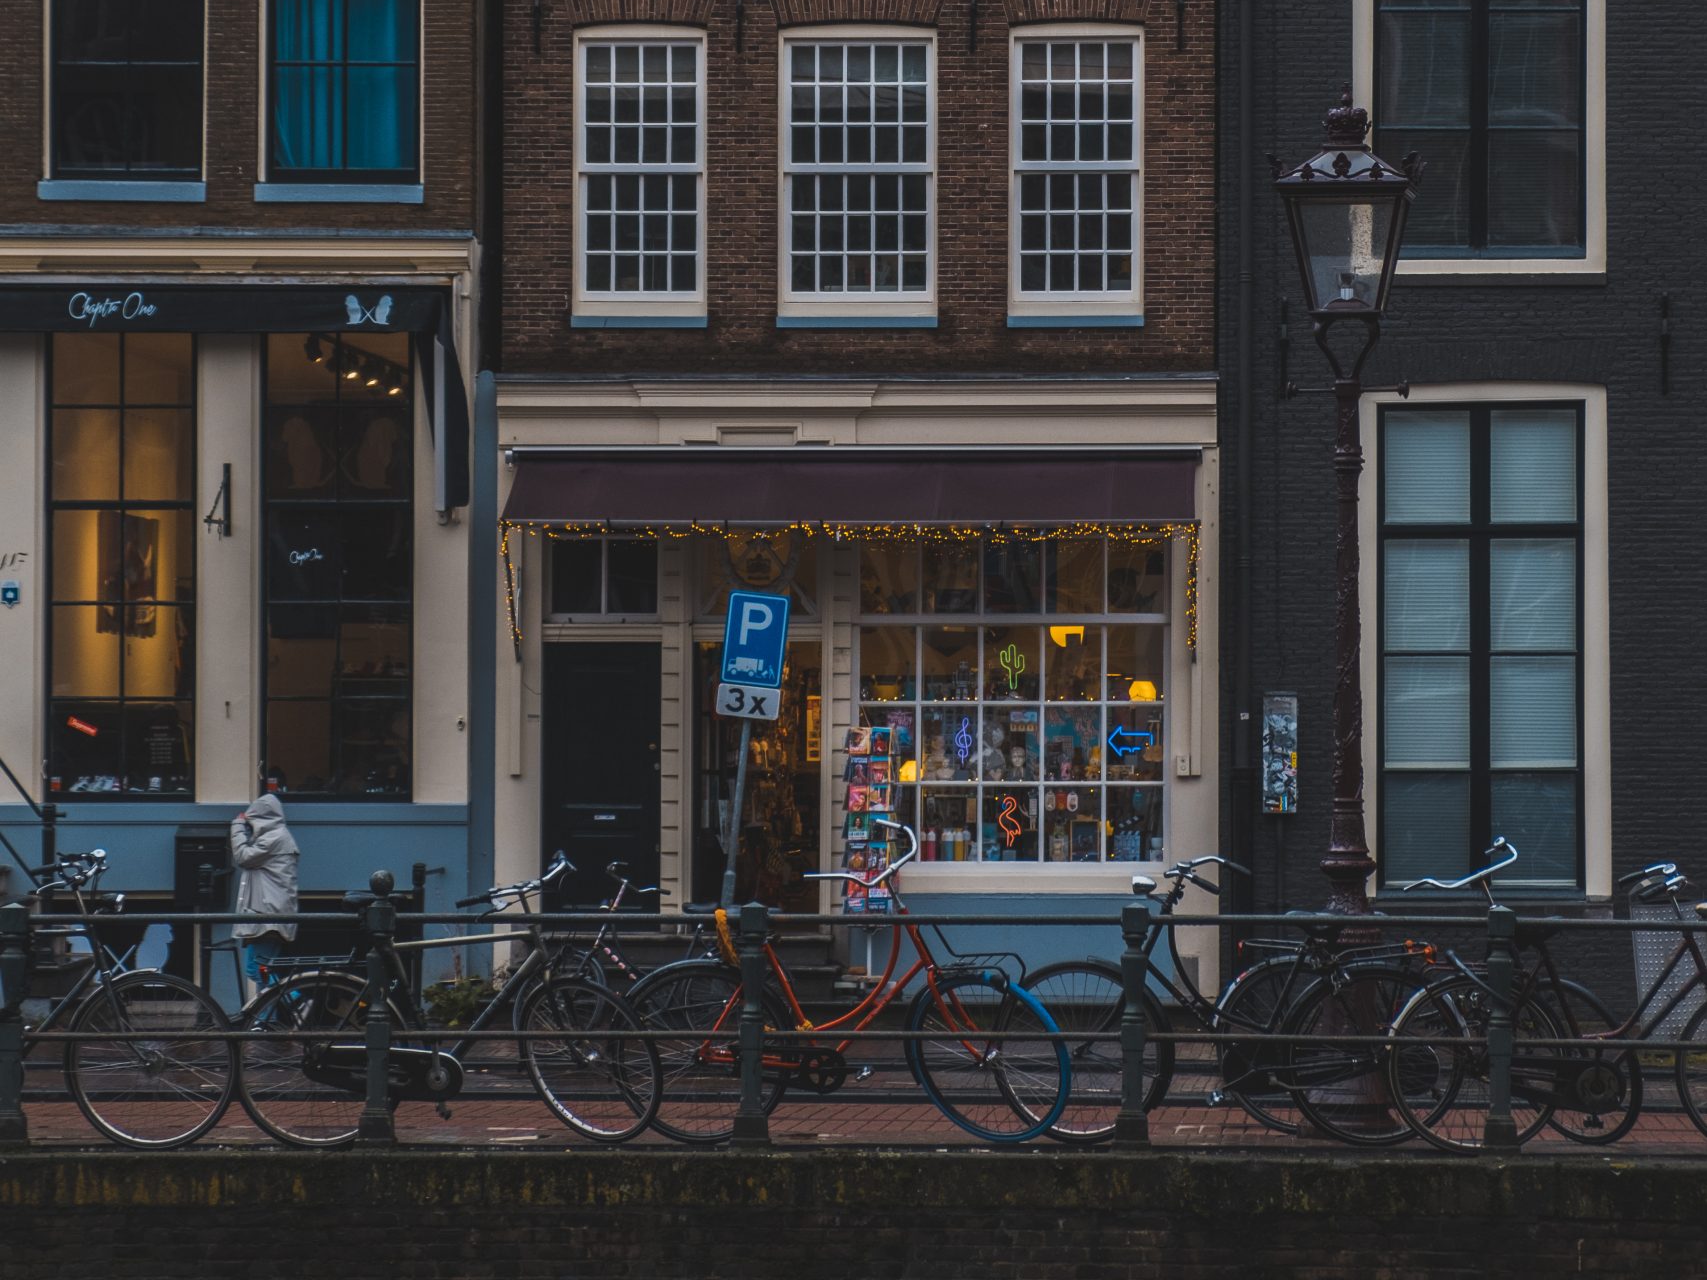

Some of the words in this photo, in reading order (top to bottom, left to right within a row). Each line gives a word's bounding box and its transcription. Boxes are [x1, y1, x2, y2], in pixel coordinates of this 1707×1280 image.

[122, 292, 157, 319] One
[739, 601, 773, 645] P
[725, 687, 768, 716] 3x
